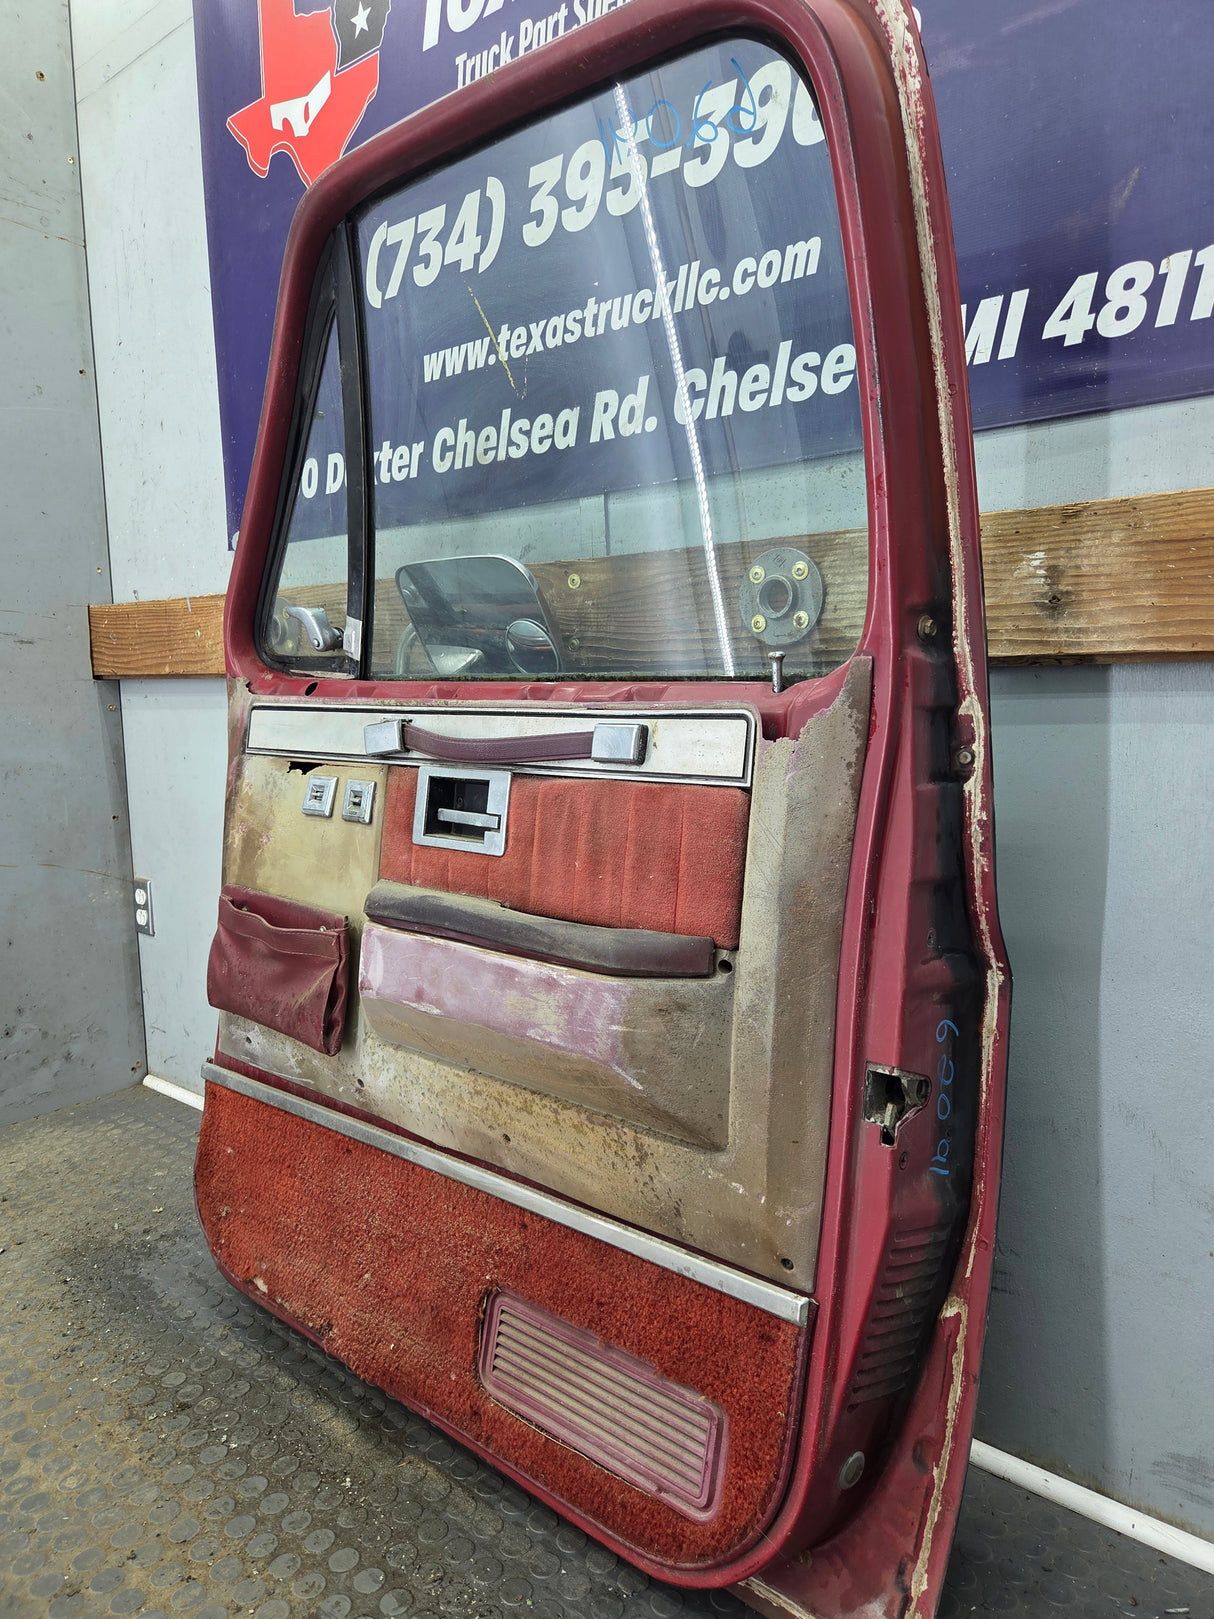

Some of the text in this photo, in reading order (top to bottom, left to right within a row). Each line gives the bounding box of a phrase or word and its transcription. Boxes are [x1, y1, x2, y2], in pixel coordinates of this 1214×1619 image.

[455, 30, 515, 89] Truck
[518, 3, 568, 57] Part
[366, 176, 506, 309] (734)
[423, 236, 822, 383] www.texastruckllc.com
[325, 440, 425, 495] Dter
[432, 407, 580, 474] Chelsea
[589, 375, 658, 443] Rd.
